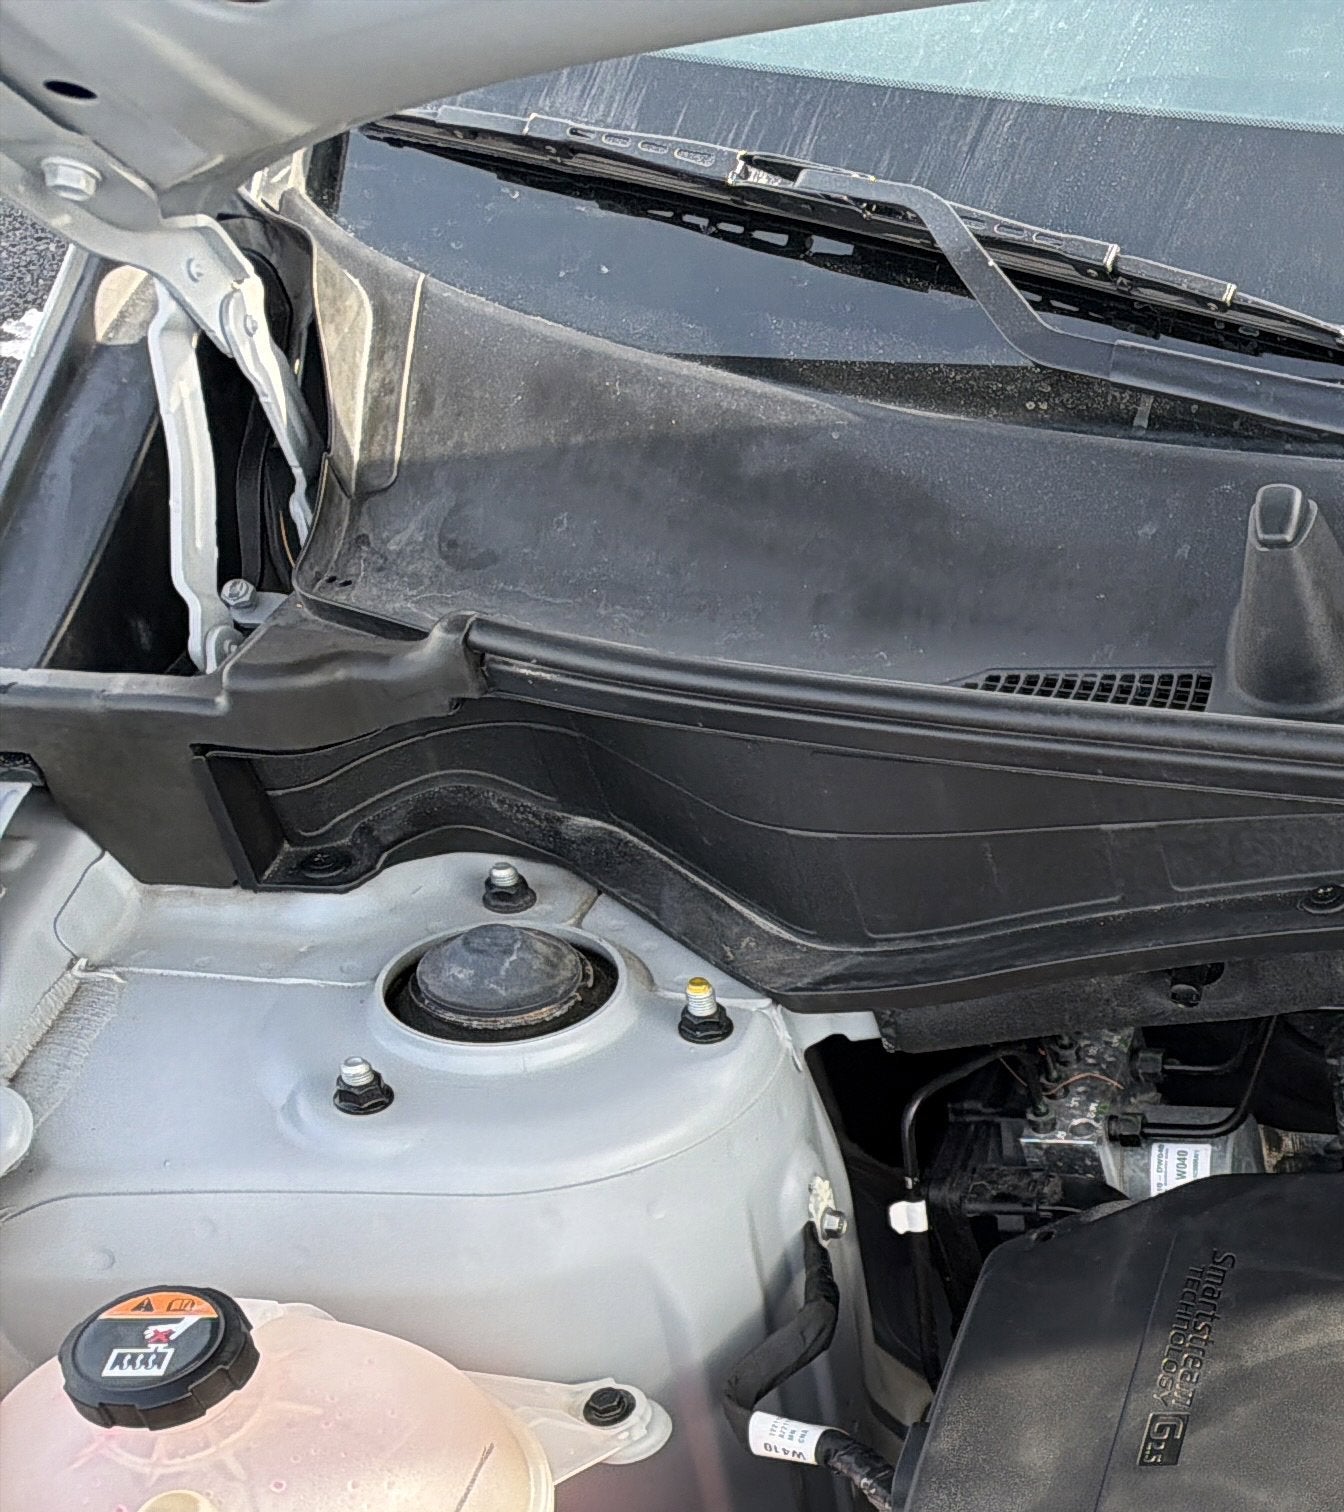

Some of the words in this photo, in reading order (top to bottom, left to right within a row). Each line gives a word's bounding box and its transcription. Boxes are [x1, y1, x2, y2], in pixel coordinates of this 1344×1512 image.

[1176, 1150, 1189, 1180] W040
[1152, 1265, 1205, 1407] TECHNOLOGY
[1172, 1248, 1236, 1408] Smartstream
